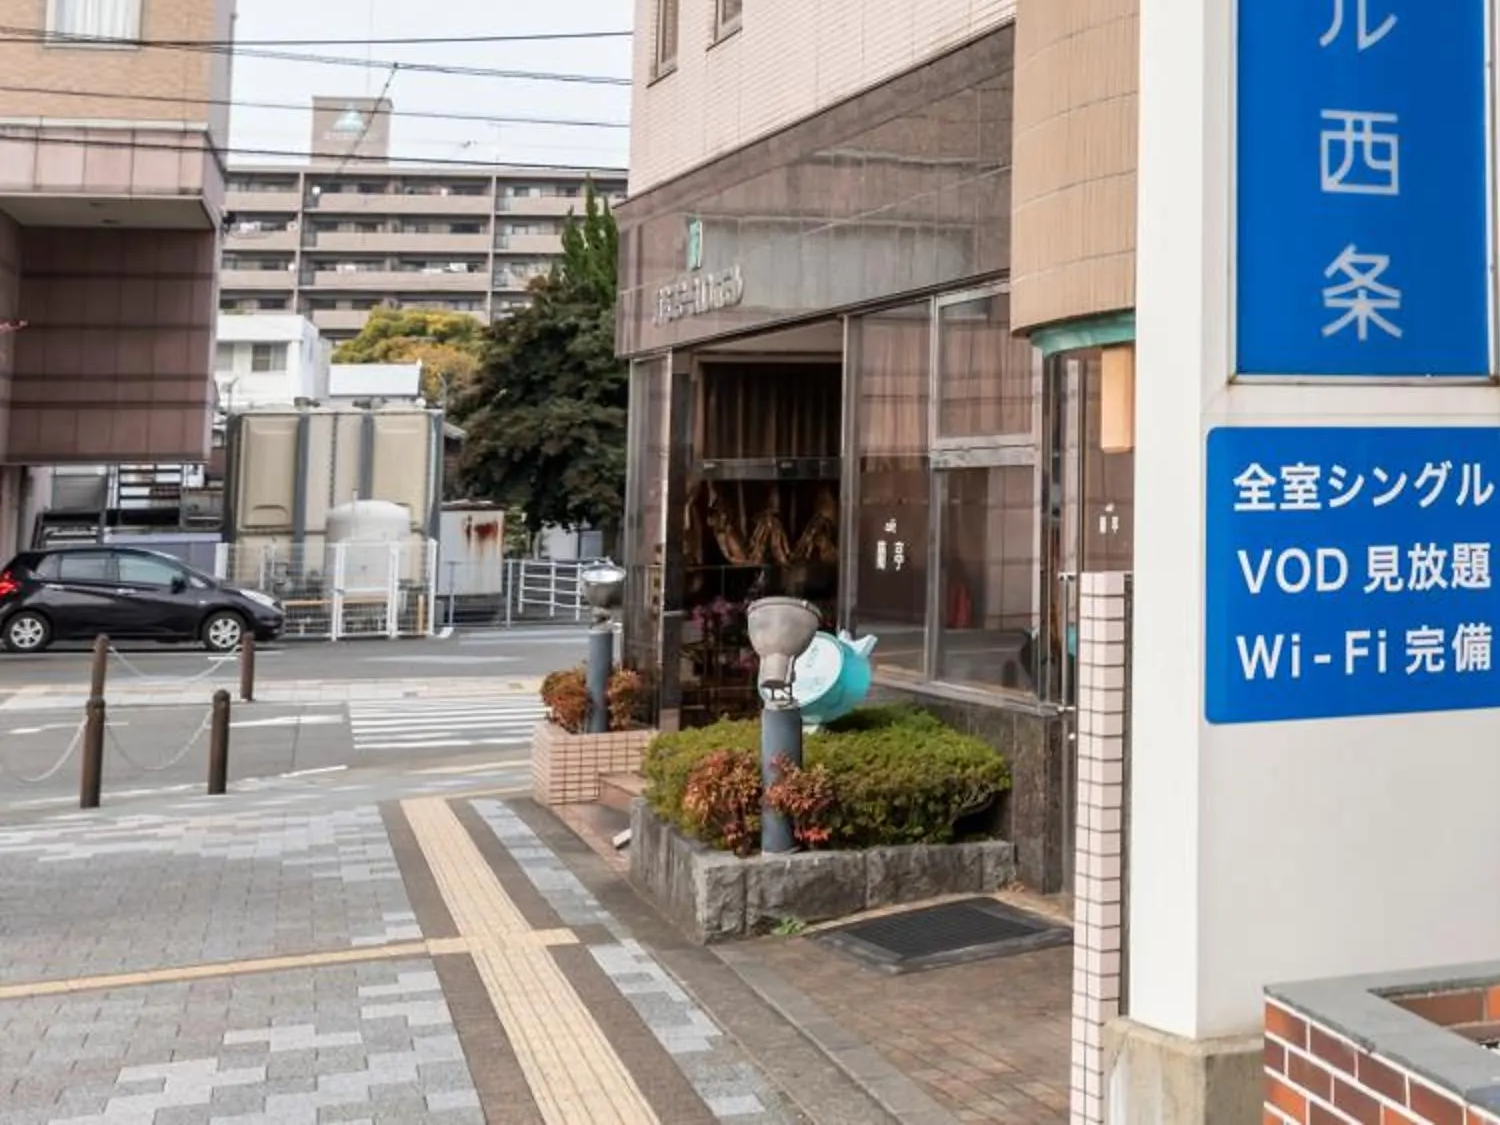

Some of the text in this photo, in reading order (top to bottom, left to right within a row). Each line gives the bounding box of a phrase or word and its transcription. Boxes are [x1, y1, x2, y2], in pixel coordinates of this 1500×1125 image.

[1233, 460, 1494, 511] 全室シングル
[1237, 542, 1491, 594] VOD 見放題
[1236, 622, 1492, 680] Wi-Fi 完備
